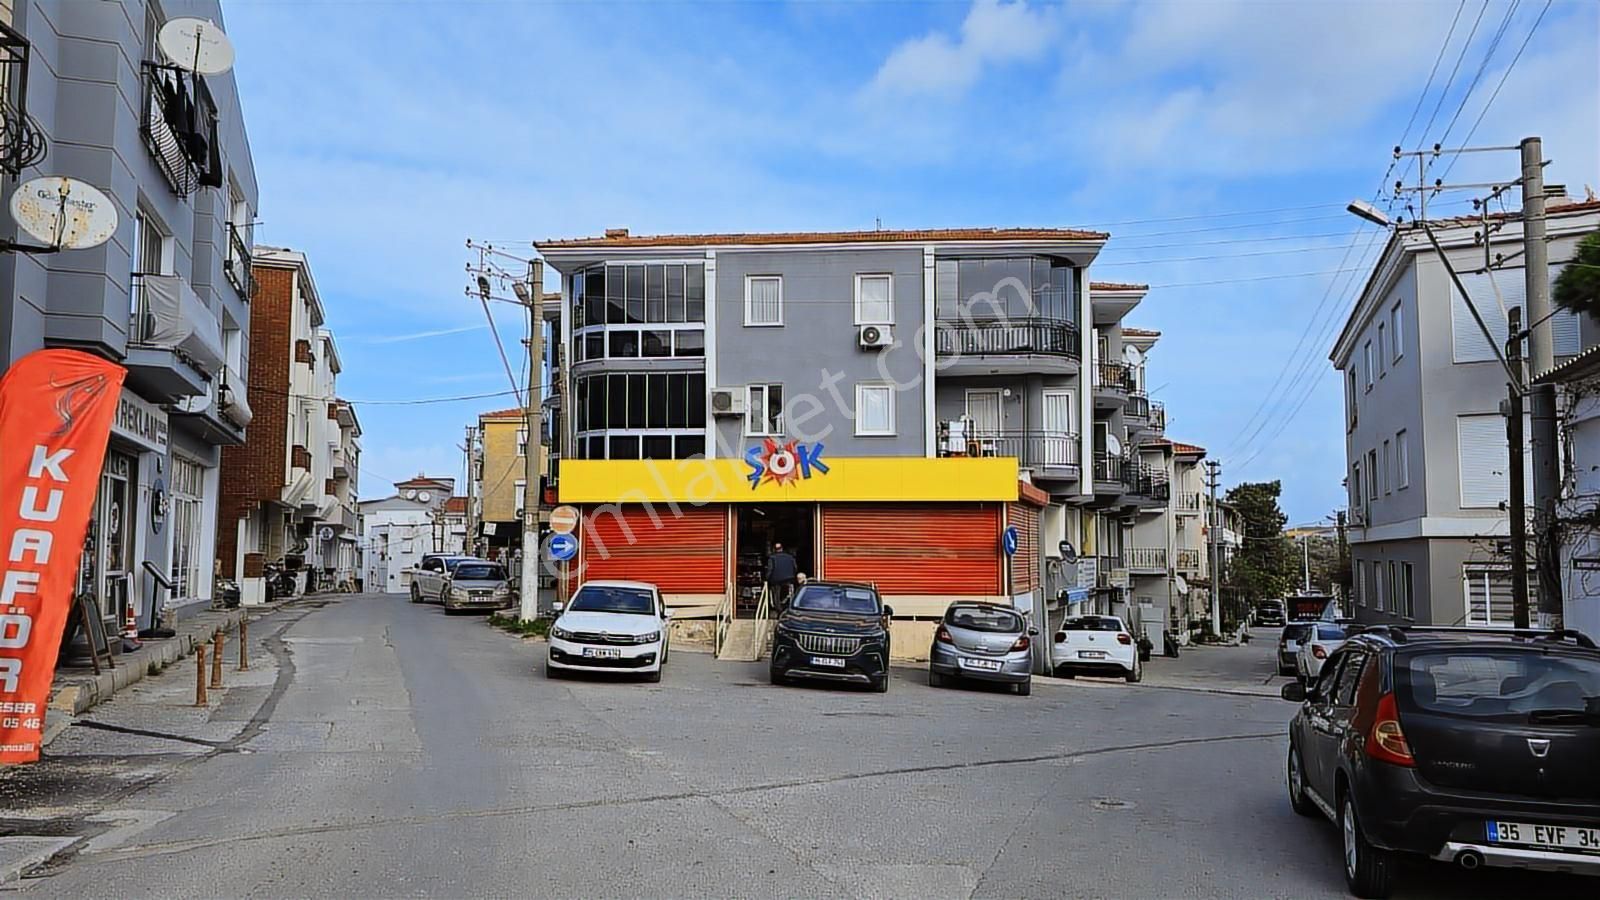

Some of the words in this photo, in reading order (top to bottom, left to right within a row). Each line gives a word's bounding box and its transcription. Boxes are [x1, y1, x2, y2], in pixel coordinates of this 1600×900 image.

[744, 442, 830, 490] ŞOK
[1499, 823, 1520, 841] 35
[1534, 826, 1566, 845] EVF
